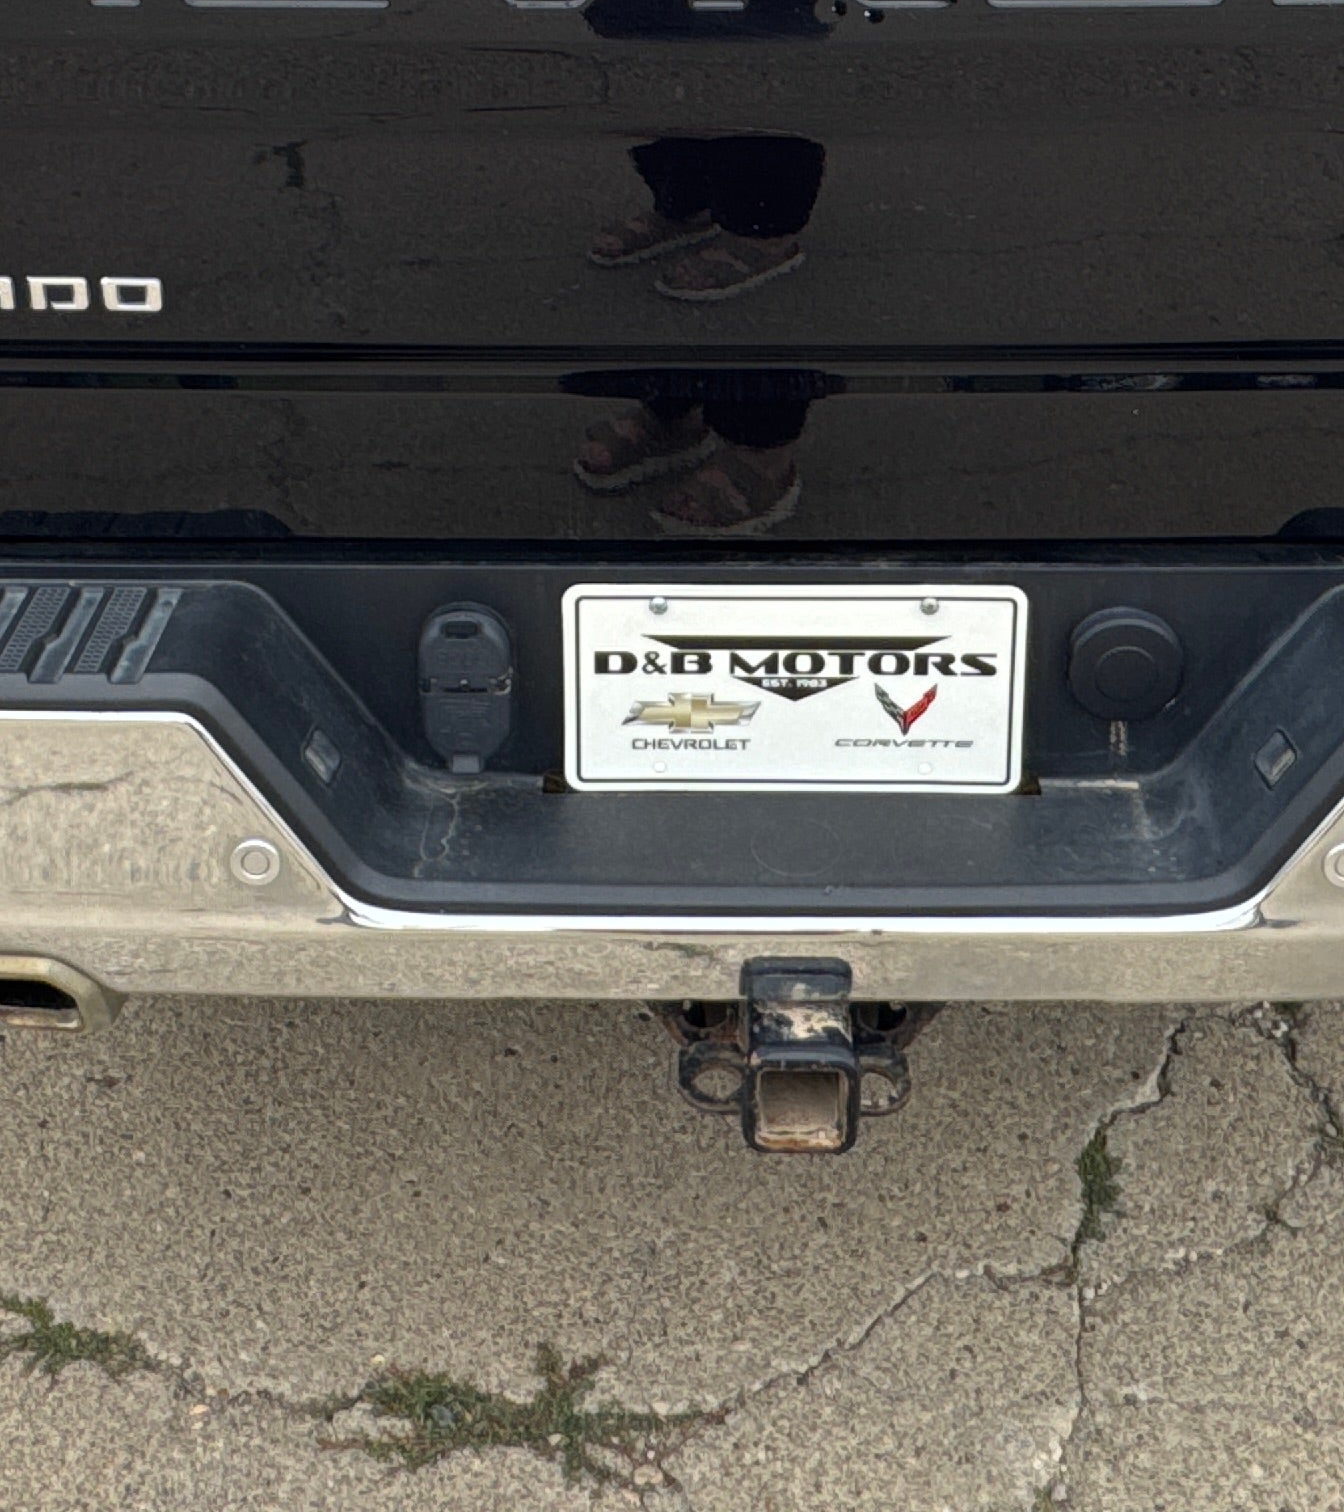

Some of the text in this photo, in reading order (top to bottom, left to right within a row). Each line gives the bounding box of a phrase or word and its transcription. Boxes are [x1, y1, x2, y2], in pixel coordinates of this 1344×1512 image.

[594, 651, 998, 677] D&B MOTORS
[631, 737, 751, 751] CHEVROLET
[834, 738, 975, 749] CORVETTE
